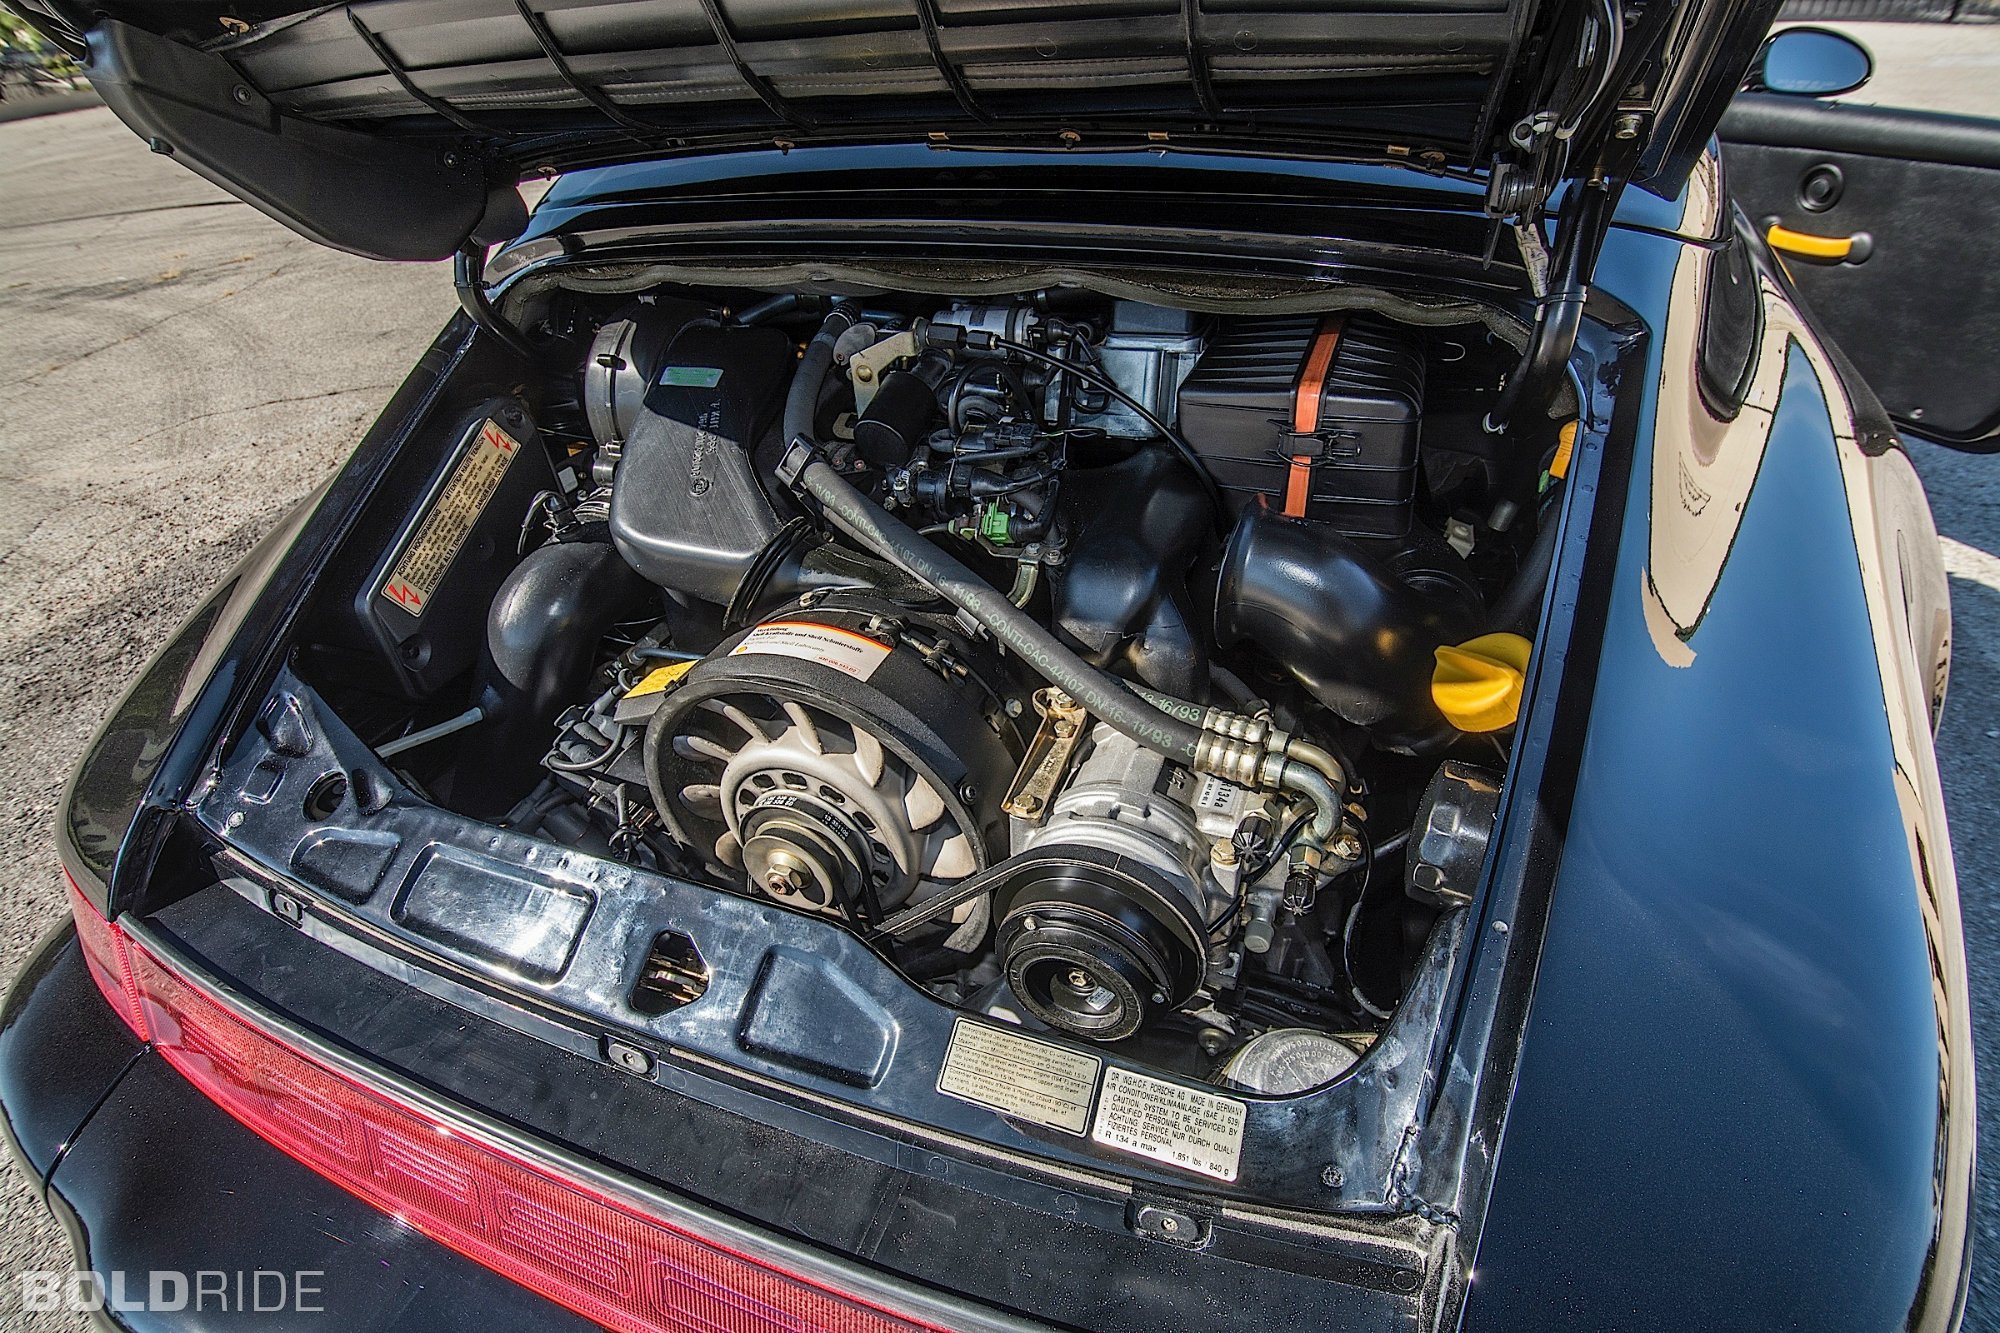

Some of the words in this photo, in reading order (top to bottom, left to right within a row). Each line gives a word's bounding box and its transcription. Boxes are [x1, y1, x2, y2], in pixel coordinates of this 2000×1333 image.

[444, 472, 463, 500] ATTENTION
[461, 456, 473, 473] HAUTE
[471, 436, 485, 457] TENSION
[475, 489, 489, 509] DANGER
[487, 477, 496, 490] HIGH
[494, 457, 508, 479] VOLTAGE
[397, 550, 416, 576] ACHTUNG
[413, 508, 441, 551] HOCHSPANNUNG
[424, 562, 446, 594] ATTENZIONE
[443, 548, 454, 563] ALTA
[452, 523, 469, 548] TENSIONE
[917, 559, 934, 576] DN
[1085, 690, 1106, 712] DN
[1133, 719, 1173, 748] 11/93
[1106, 1081, 1116, 1090] AIR
[1203, 1110, 1218, 1121] (SAE
[1111, 1103, 1142, 1118] QUALIFIED
[1145, 1113, 1181, 1130] PERSONNEL
[1185, 1125, 1201, 1136] ONLY
[1150, 1083, 1175, 1097] PORSCHE
[1177, 1091, 1185, 1100] AG
[1191, 1095, 1205, 1106] MADE
[1208, 1100, 1214, 1109] IN
[1216, 1102, 1242, 1117] GERMANY
[1107, 1121, 1138, 1136] FIZIERTES
[1141, 1131, 1173, 1147] PERSONAL
[1143, 1122, 1168, 1136] SERVICE
[1172, 1130, 1185, 1141] NUR
[1189, 1135, 1210, 1148] DURCH
[1144, 1103, 1168, 1116] SYSTEM
[1171, 1111, 1179, 1120] TO
[1183, 1115, 1191, 1123] BE
[1195, 1118, 1225, 1133] SERVICED
[1229, 1128, 1237, 1137] BY
[1115, 1134, 1129, 1144] 134
[1141, 1143, 1157, 1152] max
[1192, 1158, 1201, 1166] lbs
[1210, 1163, 1222, 1173] 840
